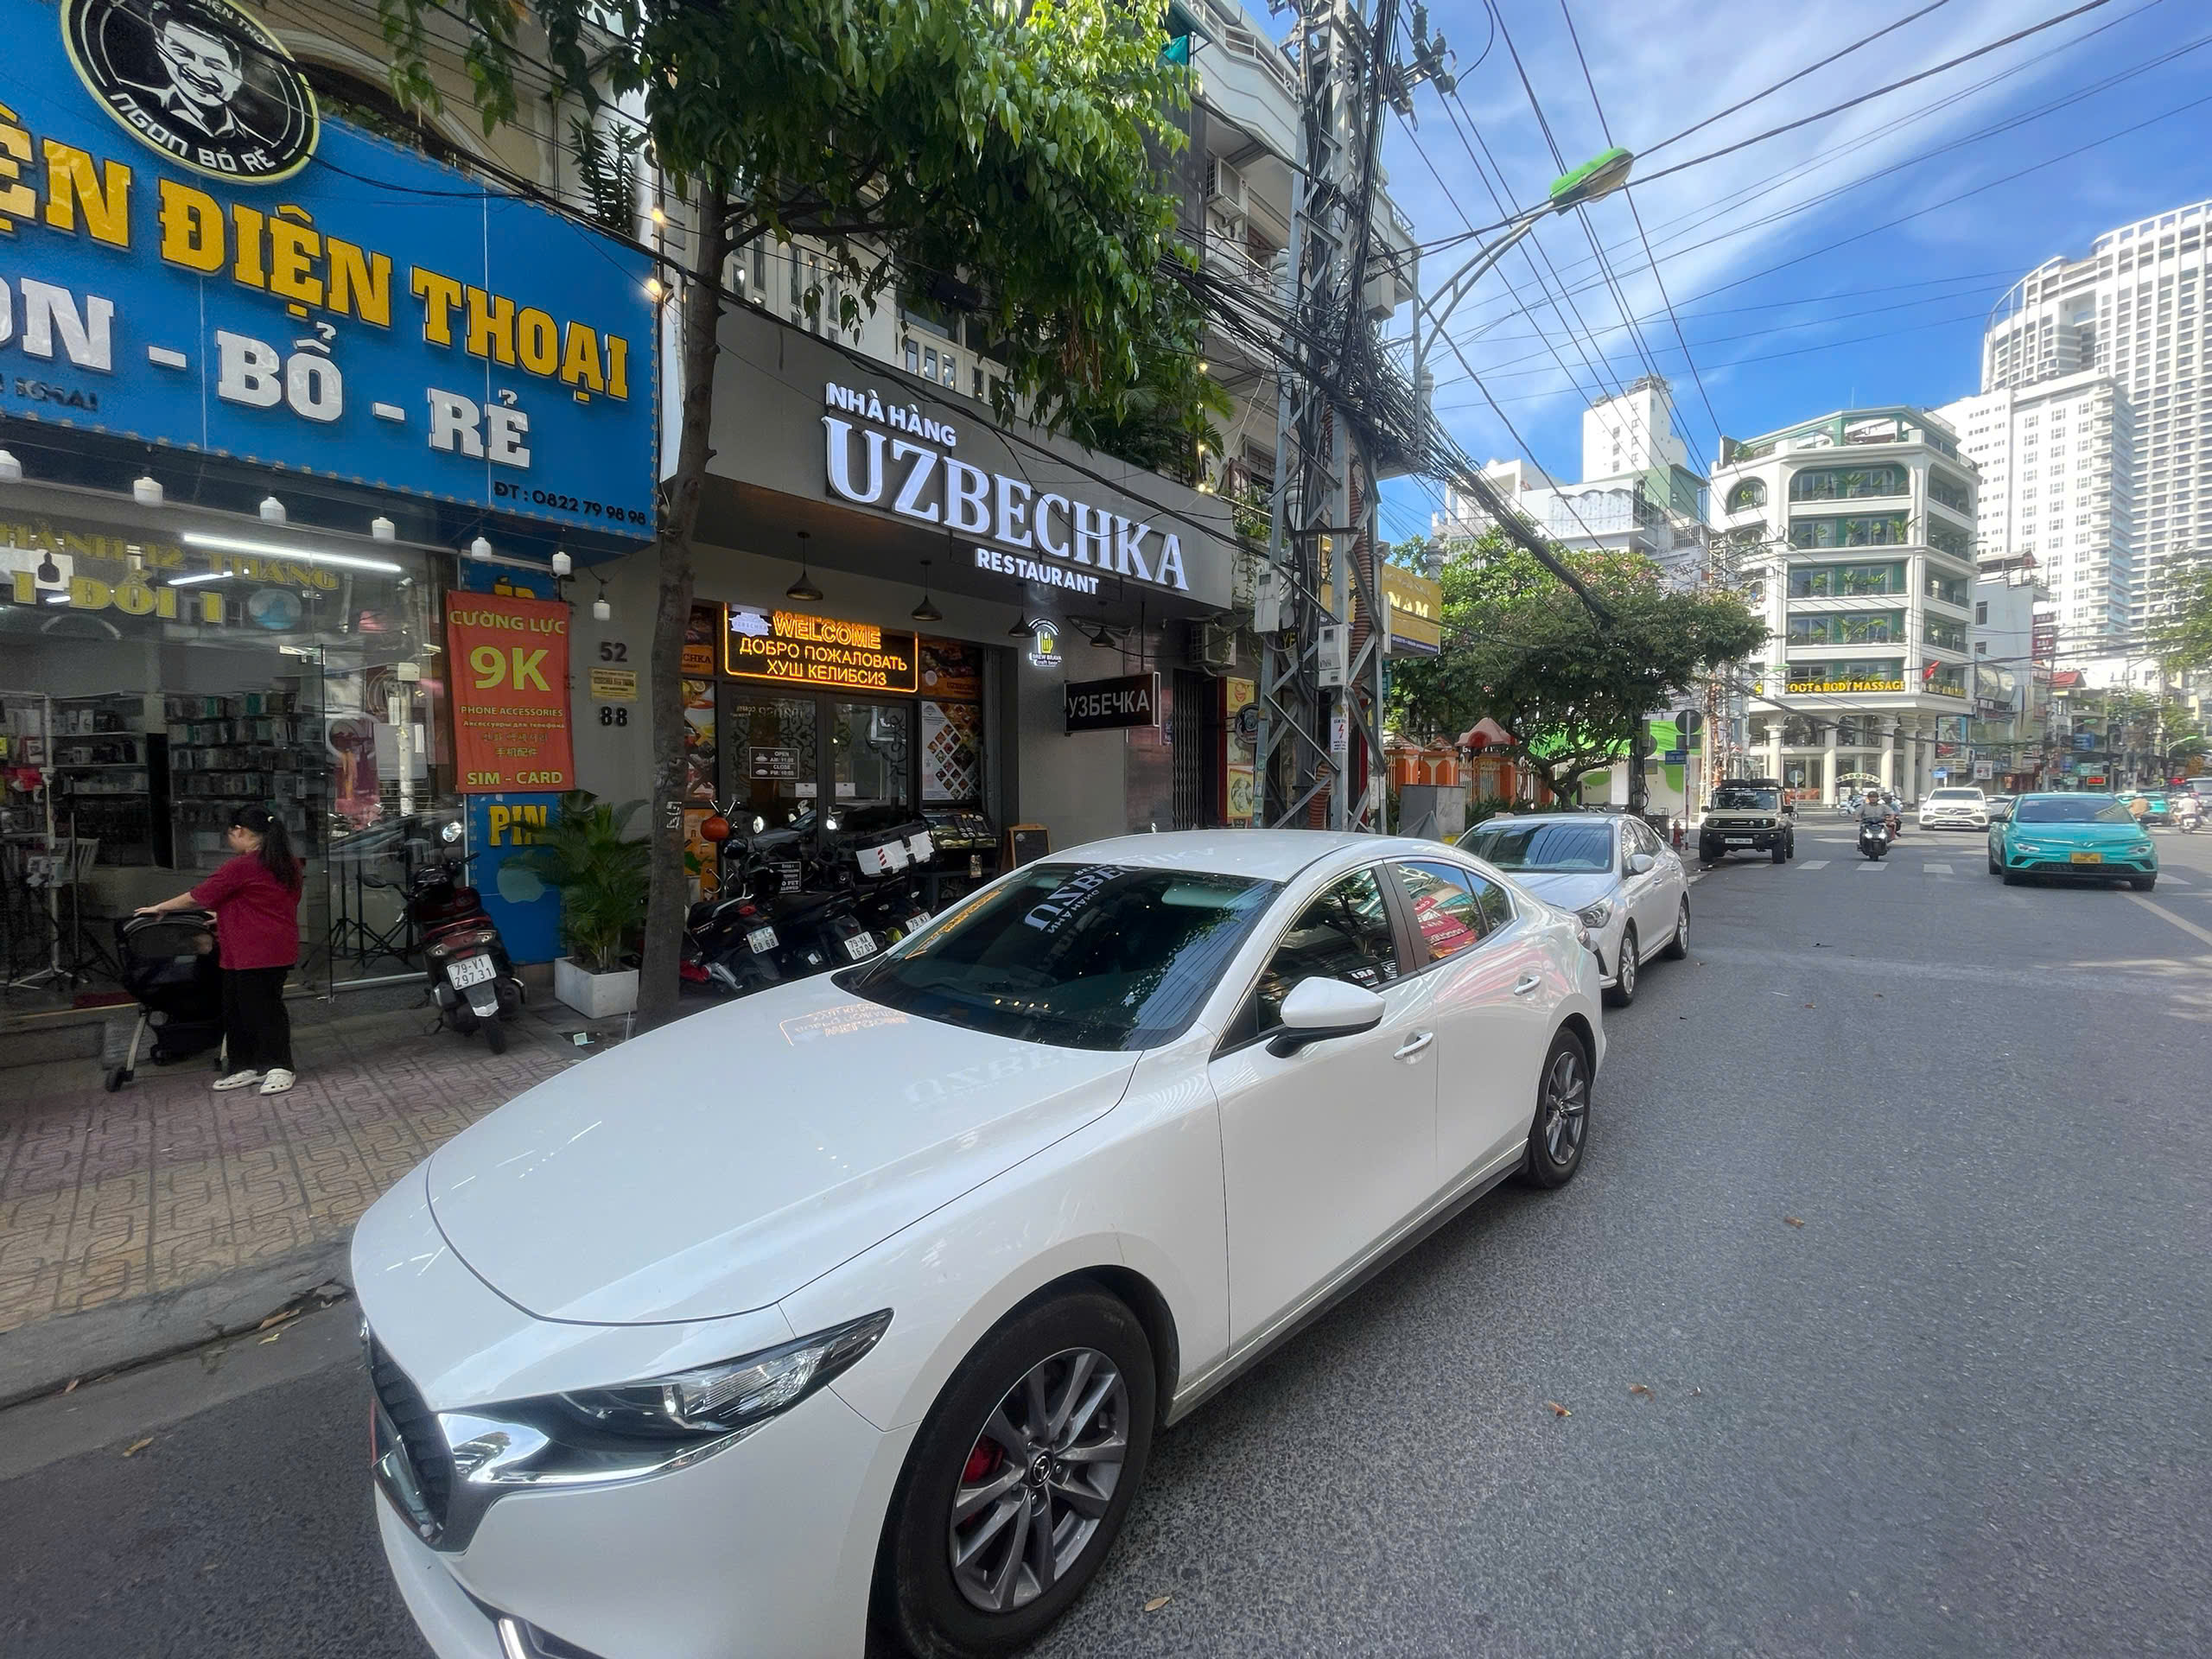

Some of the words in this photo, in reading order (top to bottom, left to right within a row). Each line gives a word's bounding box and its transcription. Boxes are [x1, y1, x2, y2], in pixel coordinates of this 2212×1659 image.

[157, 178, 392, 328] ĐIỆN
[410, 264, 629, 405] THOẠI
[0, 275, 115, 372] N
[216, 321, 343, 422] BỔ
[427, 387, 531, 468] RẺ
[825, 382, 885, 425] NHÀ
[890, 403, 957, 447] HÀNG
[494, 480, 519, 499] ĐT
[532, 489, 578, 512] 0822
[583, 499, 603, 515] 79
[606, 505, 625, 520] 98
[628, 510, 647, 525] 98
[822, 415, 1190, 592] UZBECHKA
[975, 548, 1099, 595] RESTAURANT
[449, 608, 524, 631] CƯỜNG
[530, 617, 565, 637] LỰC
[772, 613, 882, 650] WELCOME
[470, 645, 552, 692] 9K
[601, 641, 627, 663] 52
[740, 637, 800, 658] ДОБРО
[804, 645, 908, 671] ПОЖАЛОВАТЬ
[766, 658, 804, 678] ХУШ
[808, 664, 887, 686] КЕЛИБСИЗ
[1822, 682, 1852, 692] BODY
[1853, 679, 1905, 692] MASSAGE
[461, 706, 498, 715] PHONE
[499, 707, 563, 717] ACCESSORIES
[601, 706, 627, 727] 88
[1068, 689, 1150, 718] УЗБЕЧКА
[467, 772, 500, 785] SIM
[516, 771, 563, 785] CARD
